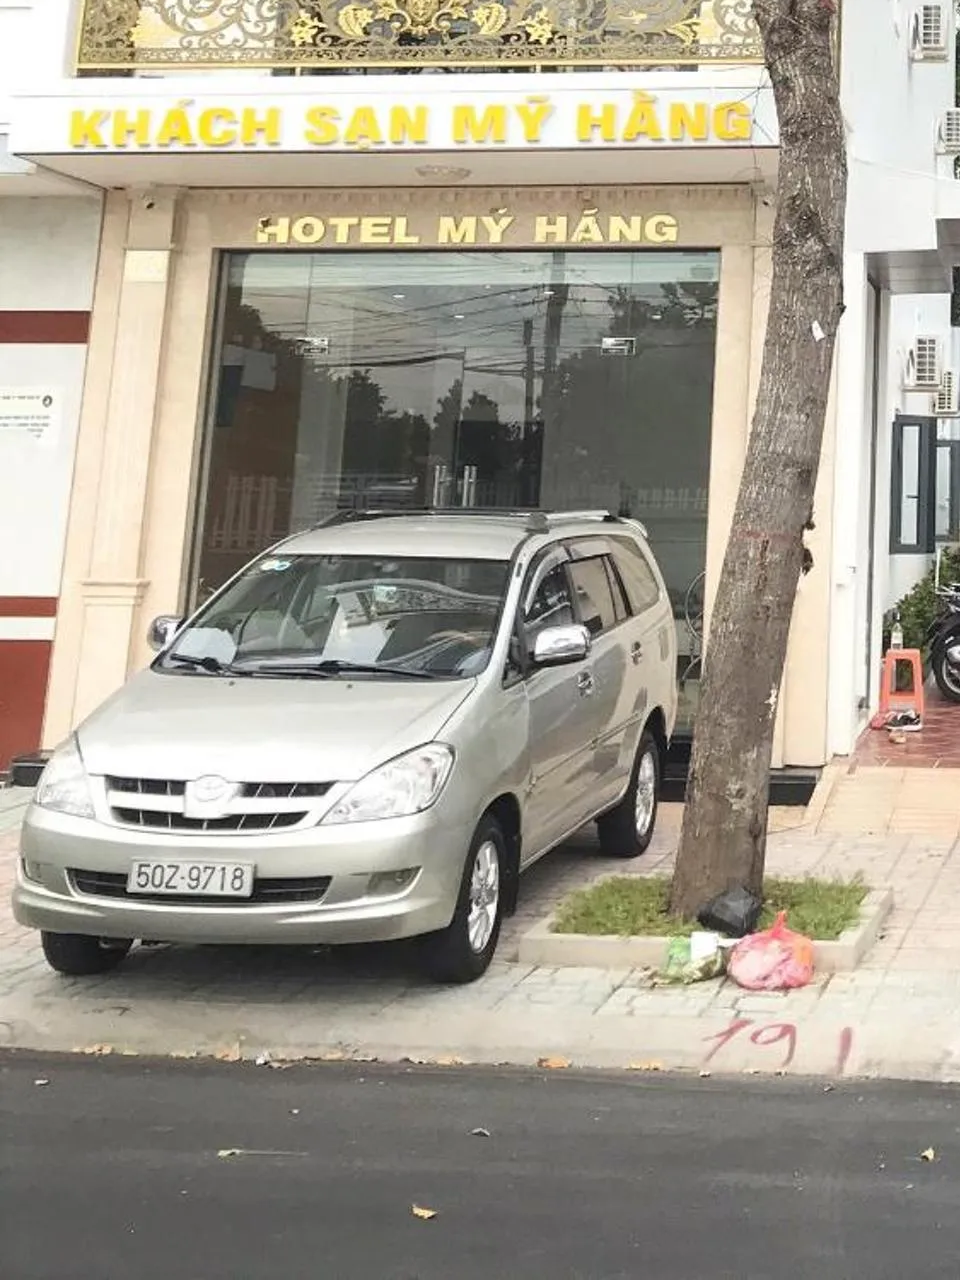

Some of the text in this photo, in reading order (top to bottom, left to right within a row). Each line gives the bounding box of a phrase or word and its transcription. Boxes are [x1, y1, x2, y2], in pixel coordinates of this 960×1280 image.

[69, 89, 752, 150] KHÁCH SẠN MỸ HẰNG
[256, 216, 420, 243] HOTEL
[137, 864, 245, 891] 50Z-9718
